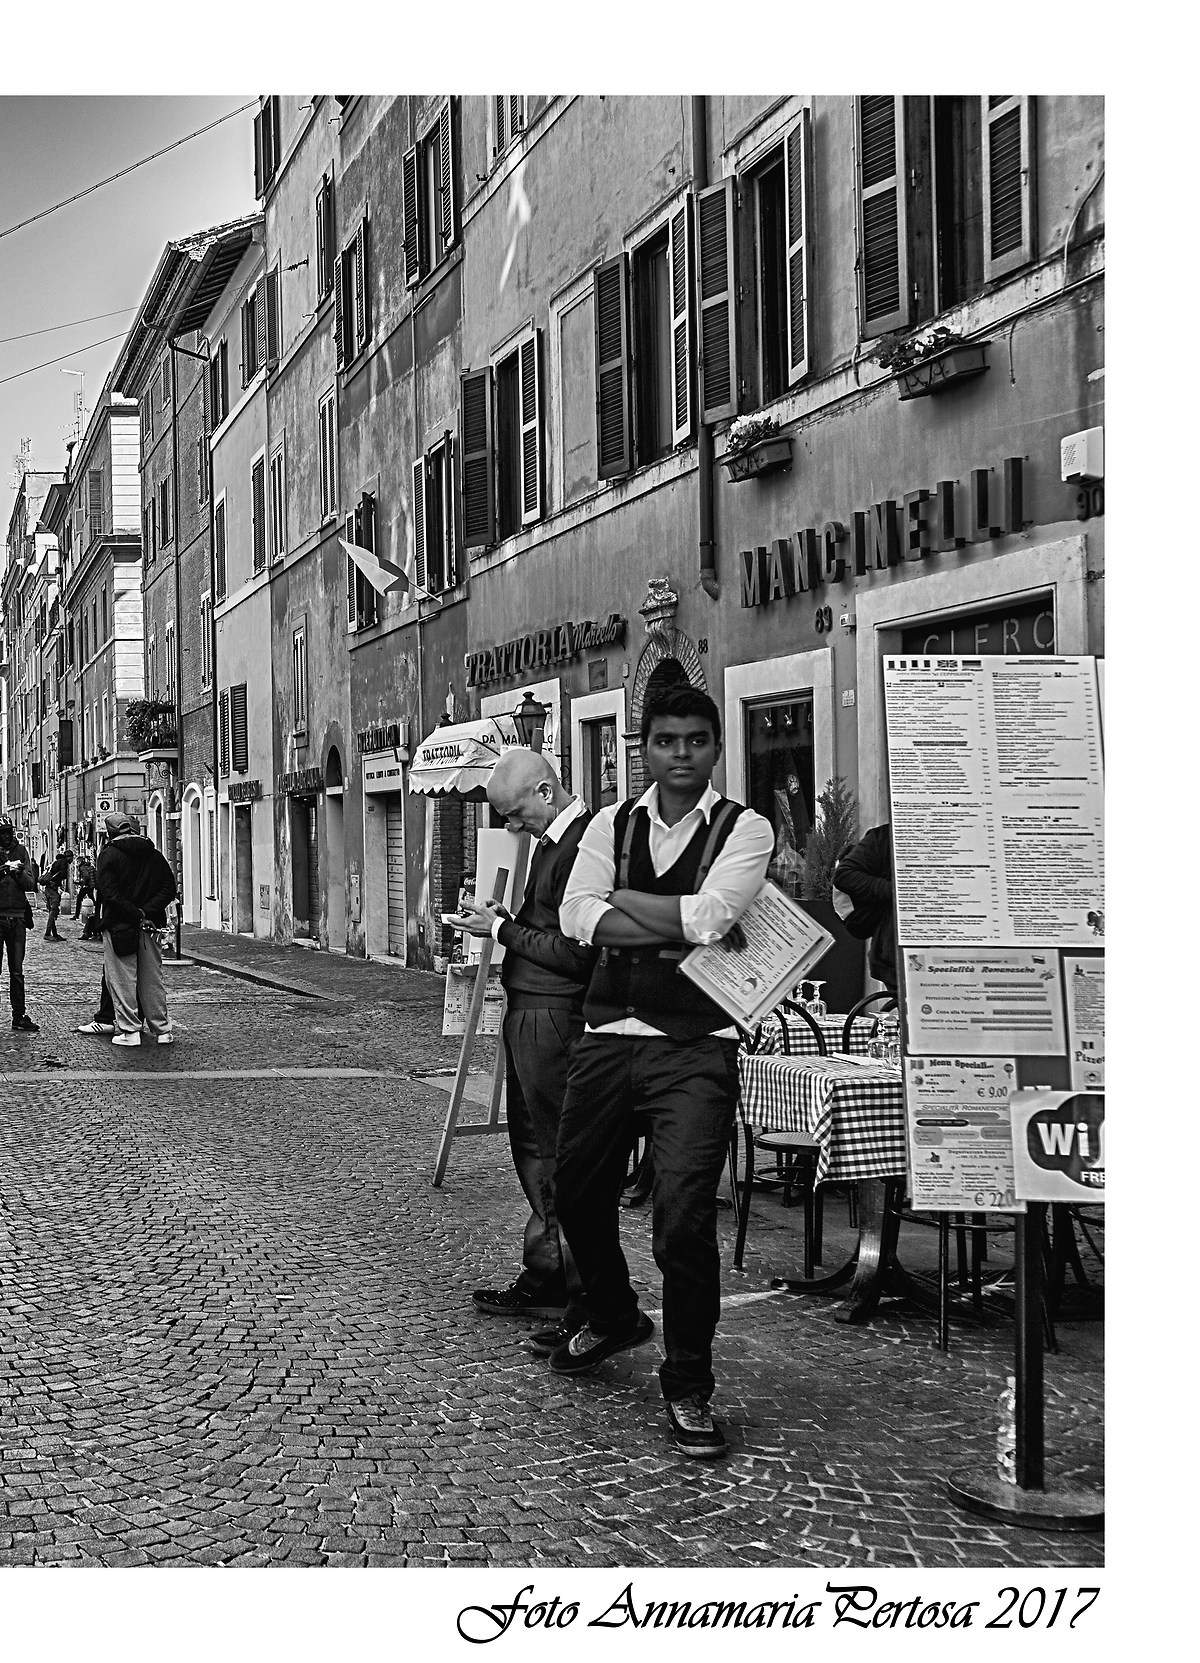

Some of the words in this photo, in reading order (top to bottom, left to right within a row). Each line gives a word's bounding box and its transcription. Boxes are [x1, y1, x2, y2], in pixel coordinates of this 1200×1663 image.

[738, 456, 1028, 608] MANCINELLI
[466, 622, 574, 687] TRATTORIA
[572, 614, 620, 651] Marcello
[698, 638, 708, 654] 88
[482, 734, 496, 744] DA
[927, 965, 975, 974] Specialità
[929, 1059, 952, 1067] Menu
[977, 1087, 985, 1097] €
[988, 1086, 1008, 1098] 9.00
[974, 1192, 985, 1206] €
